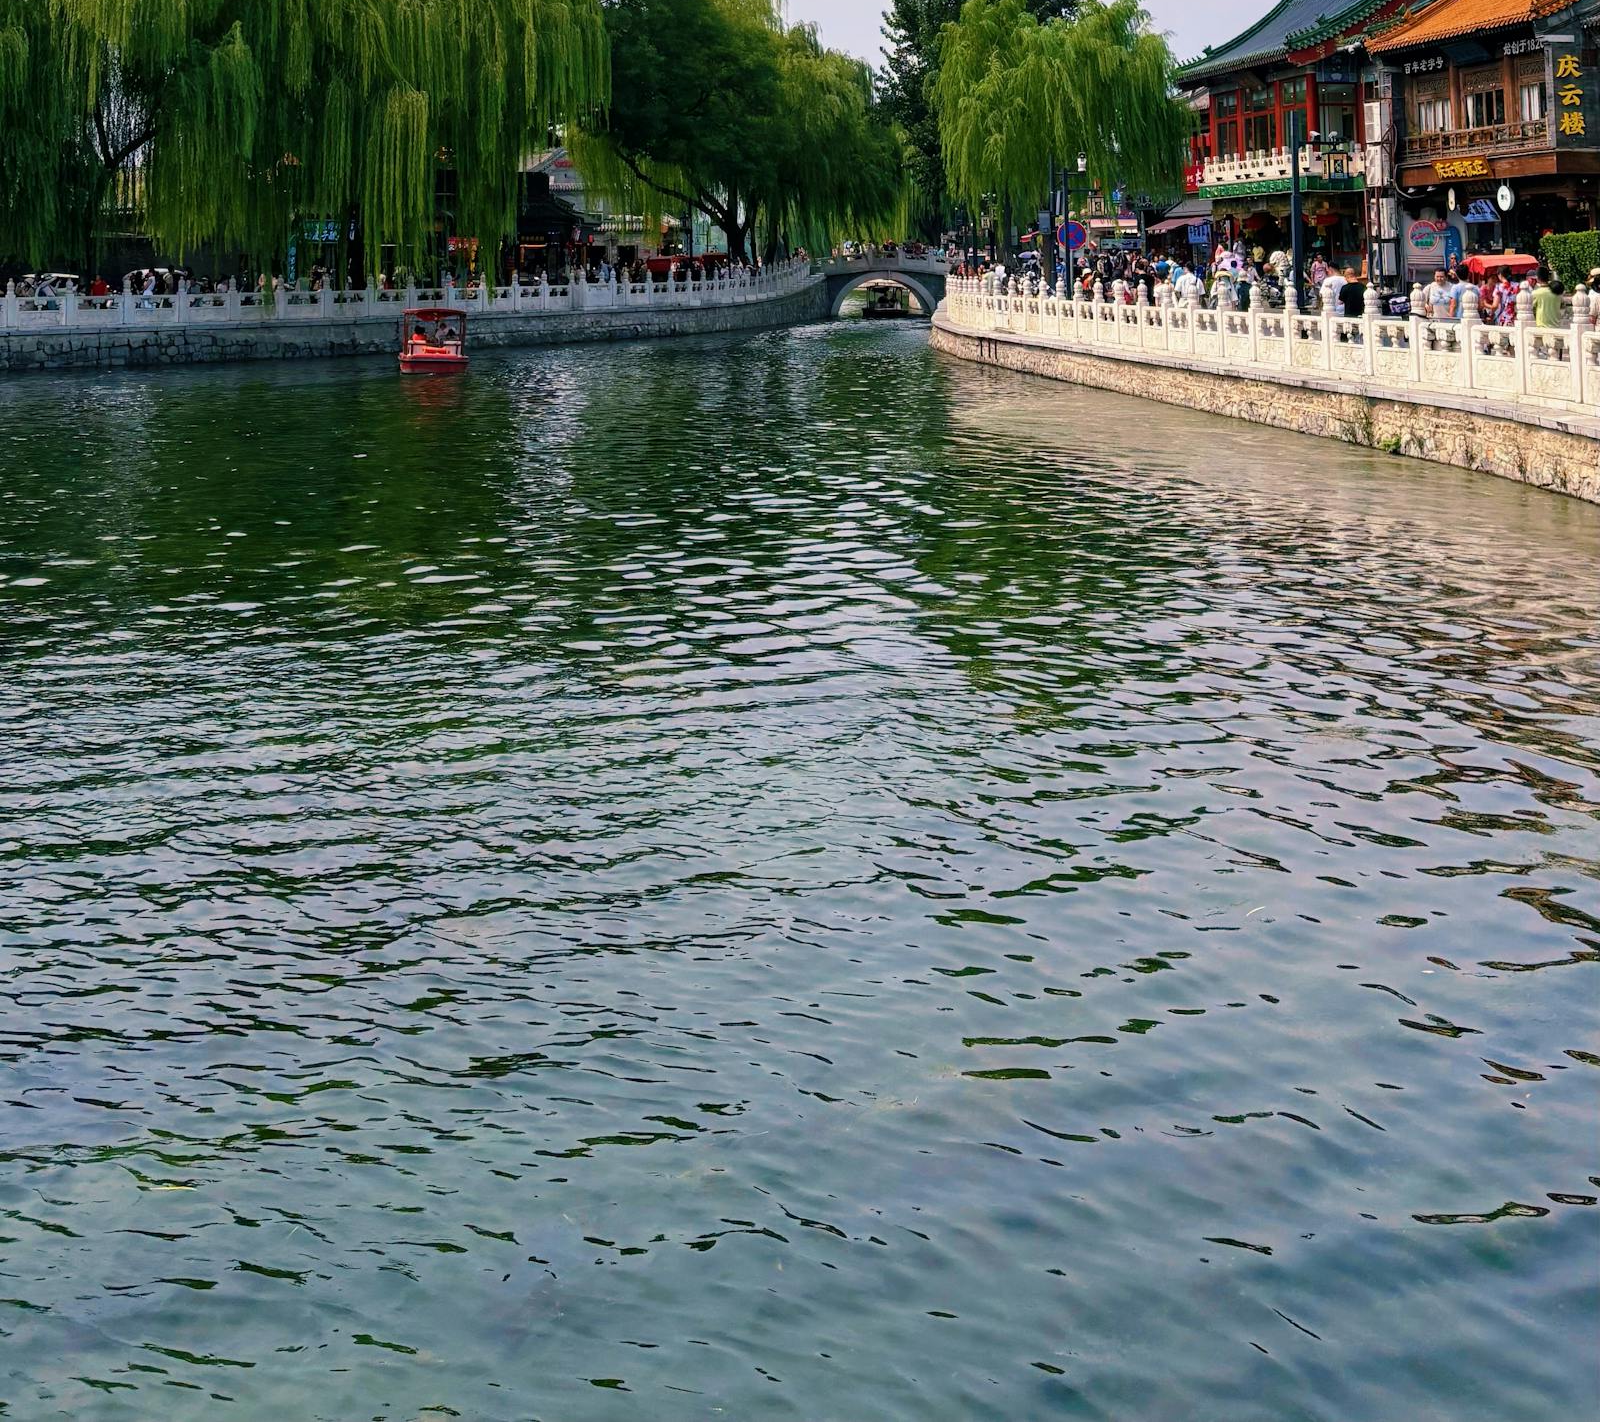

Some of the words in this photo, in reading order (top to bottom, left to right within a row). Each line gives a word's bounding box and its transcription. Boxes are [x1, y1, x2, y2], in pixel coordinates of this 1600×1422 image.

[1404, 57, 1444, 75] 百年老字号
[1556, 54, 1586, 135] 庆云楼
